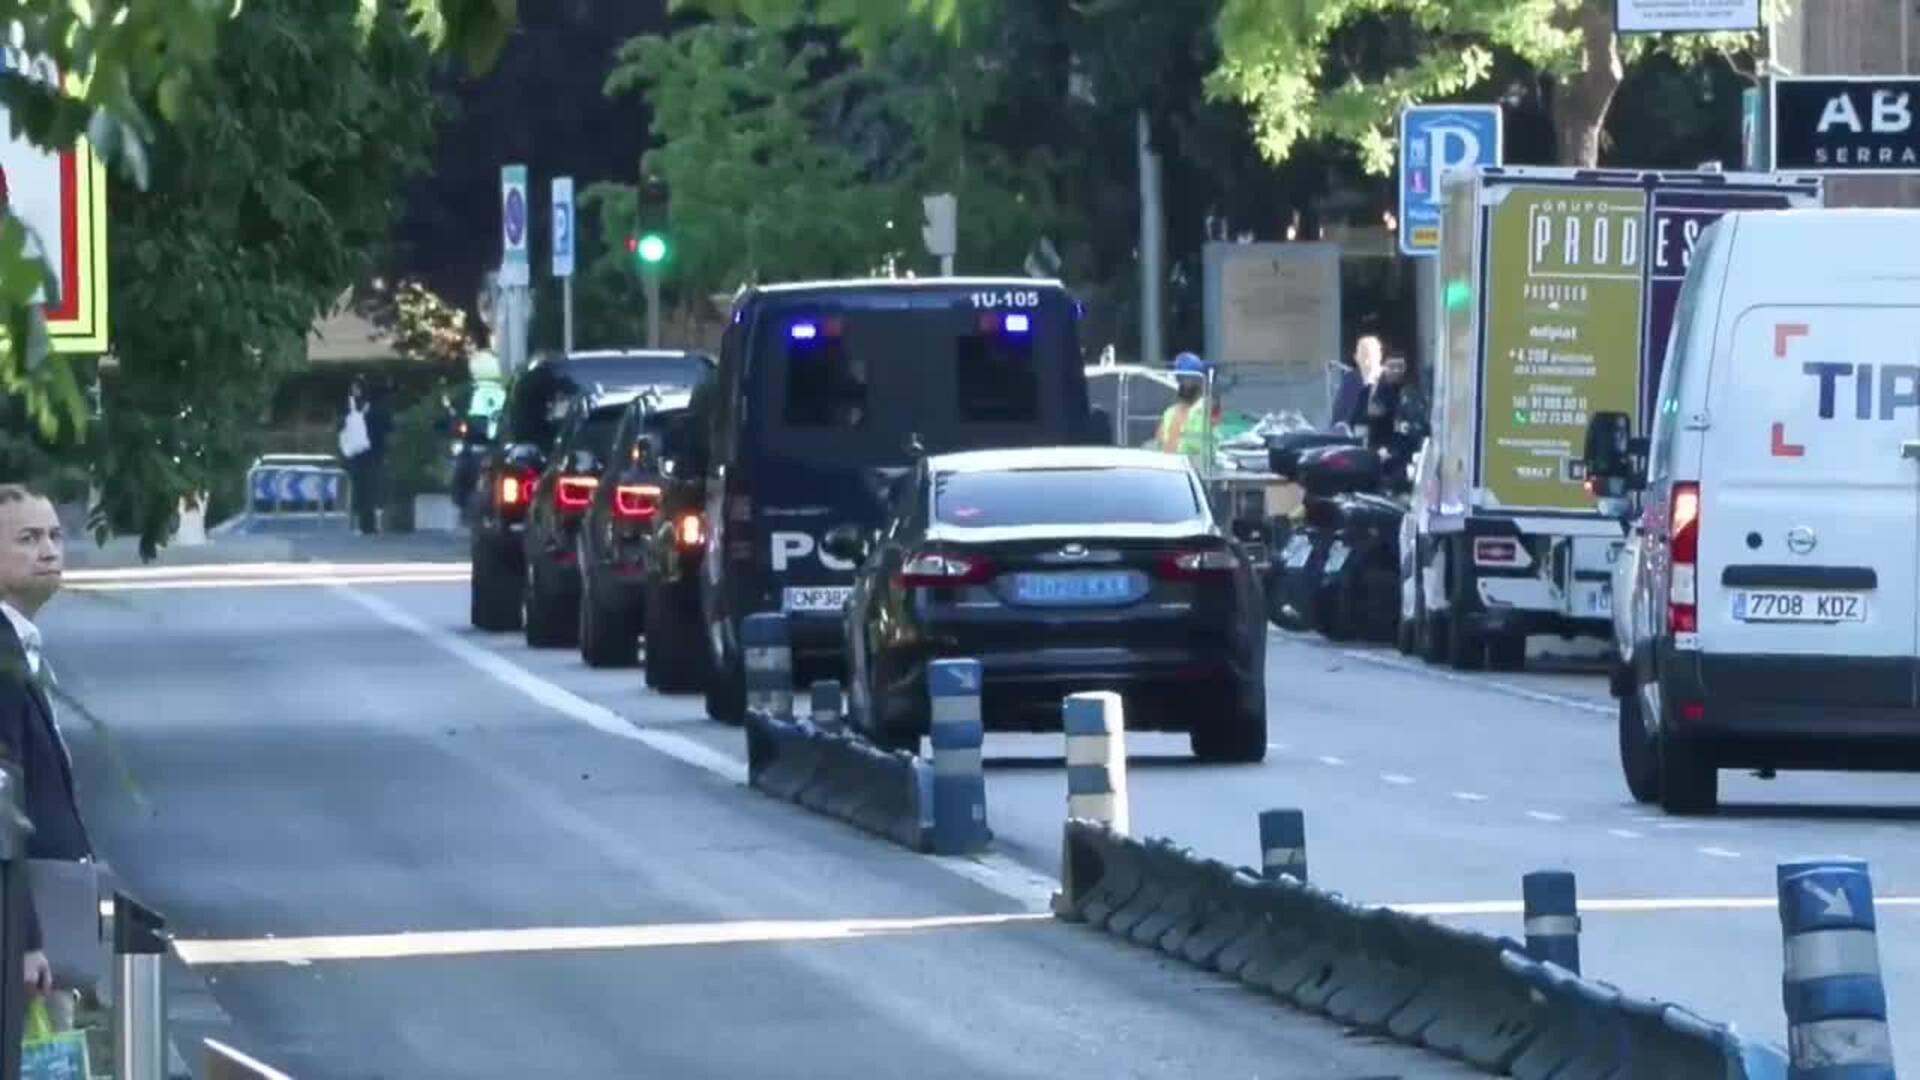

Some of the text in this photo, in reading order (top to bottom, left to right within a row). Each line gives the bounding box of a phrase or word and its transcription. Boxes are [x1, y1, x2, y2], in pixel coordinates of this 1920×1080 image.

[1817, 91, 1911, 134] AB
[1423, 126, 1480, 203] P
[1816, 148, 1916, 163] SERRA
[1542, 200, 1608, 213] GRUPO
[971, 291, 1039, 308] 1U-105
[1803, 362, 1920, 420] TIP
[1751, 594, 1858, 617] 7708 KDZ
